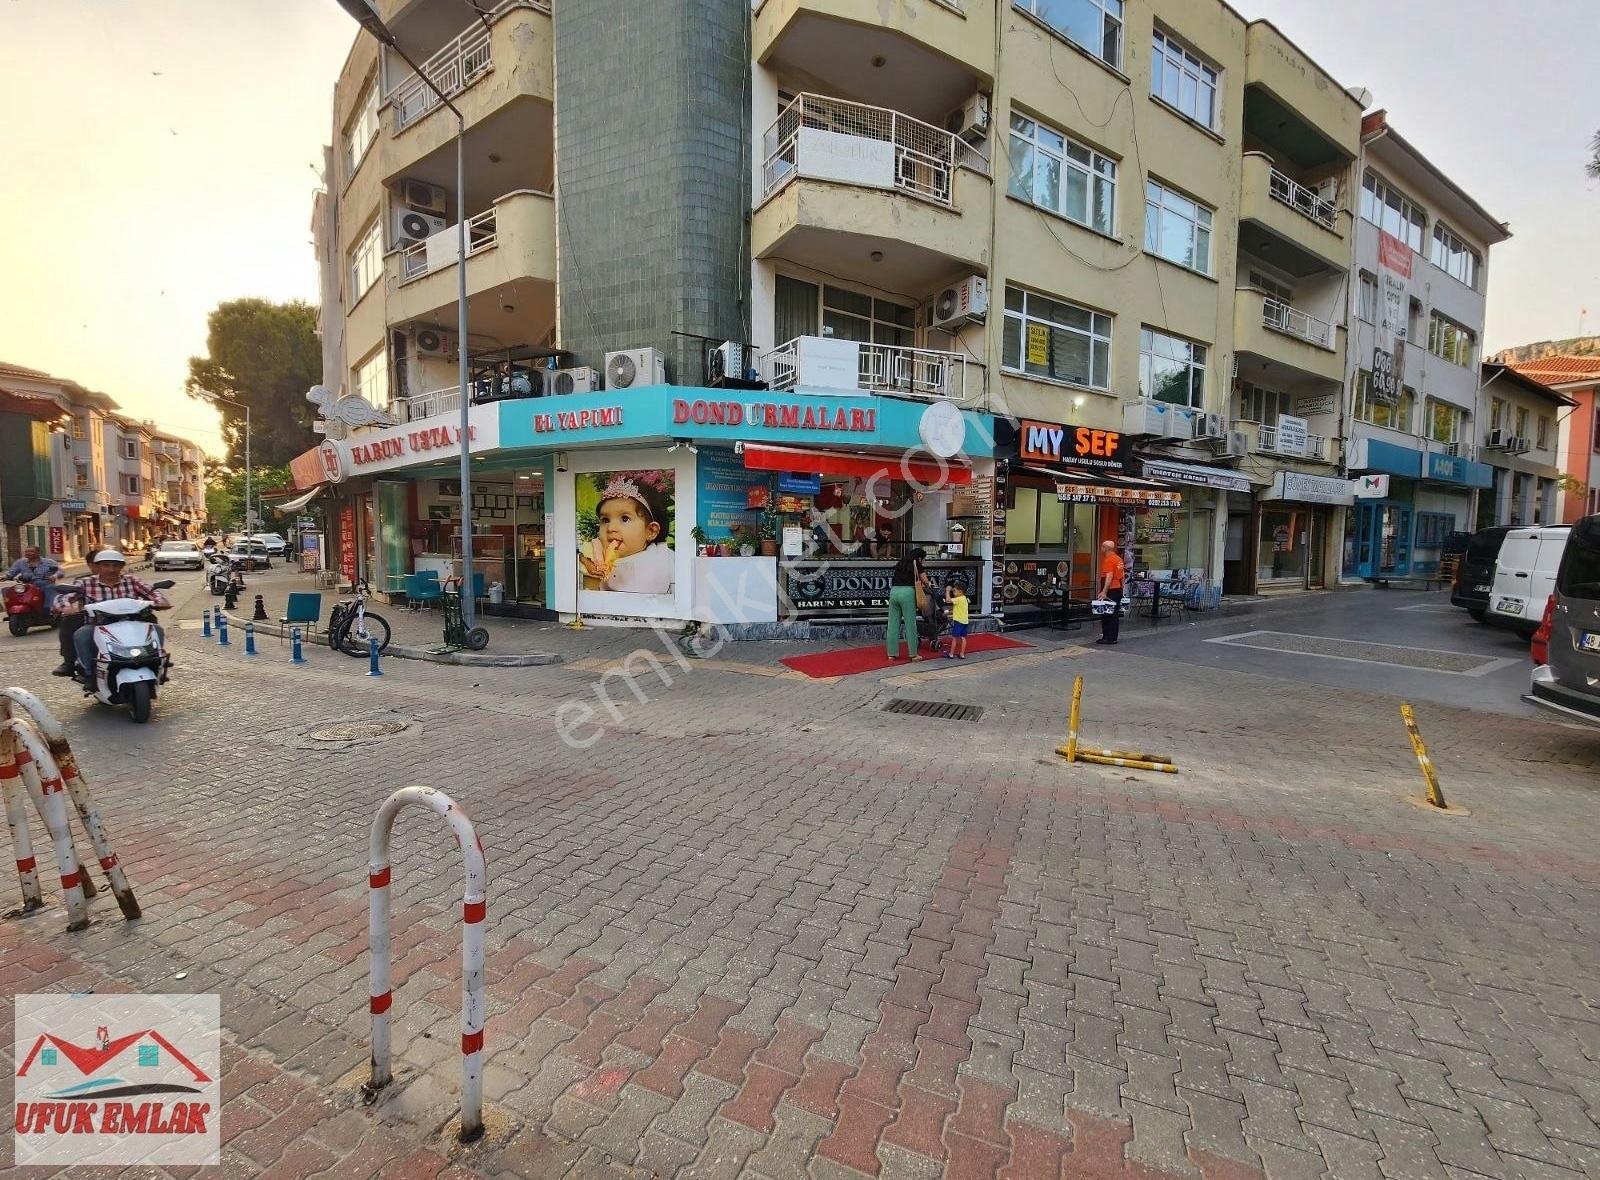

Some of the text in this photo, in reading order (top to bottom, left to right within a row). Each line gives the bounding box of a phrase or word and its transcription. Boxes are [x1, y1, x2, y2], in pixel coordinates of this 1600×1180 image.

[534, 407, 623, 432] EL YAPIMI
[673, 399, 876, 432] DONDURMALARI
[351, 436, 405, 465] HARUN
[1028, 425, 1119, 456] MY ŞEF
[798, 600, 835, 608] HARUN
[839, 599, 866, 607] USTA
